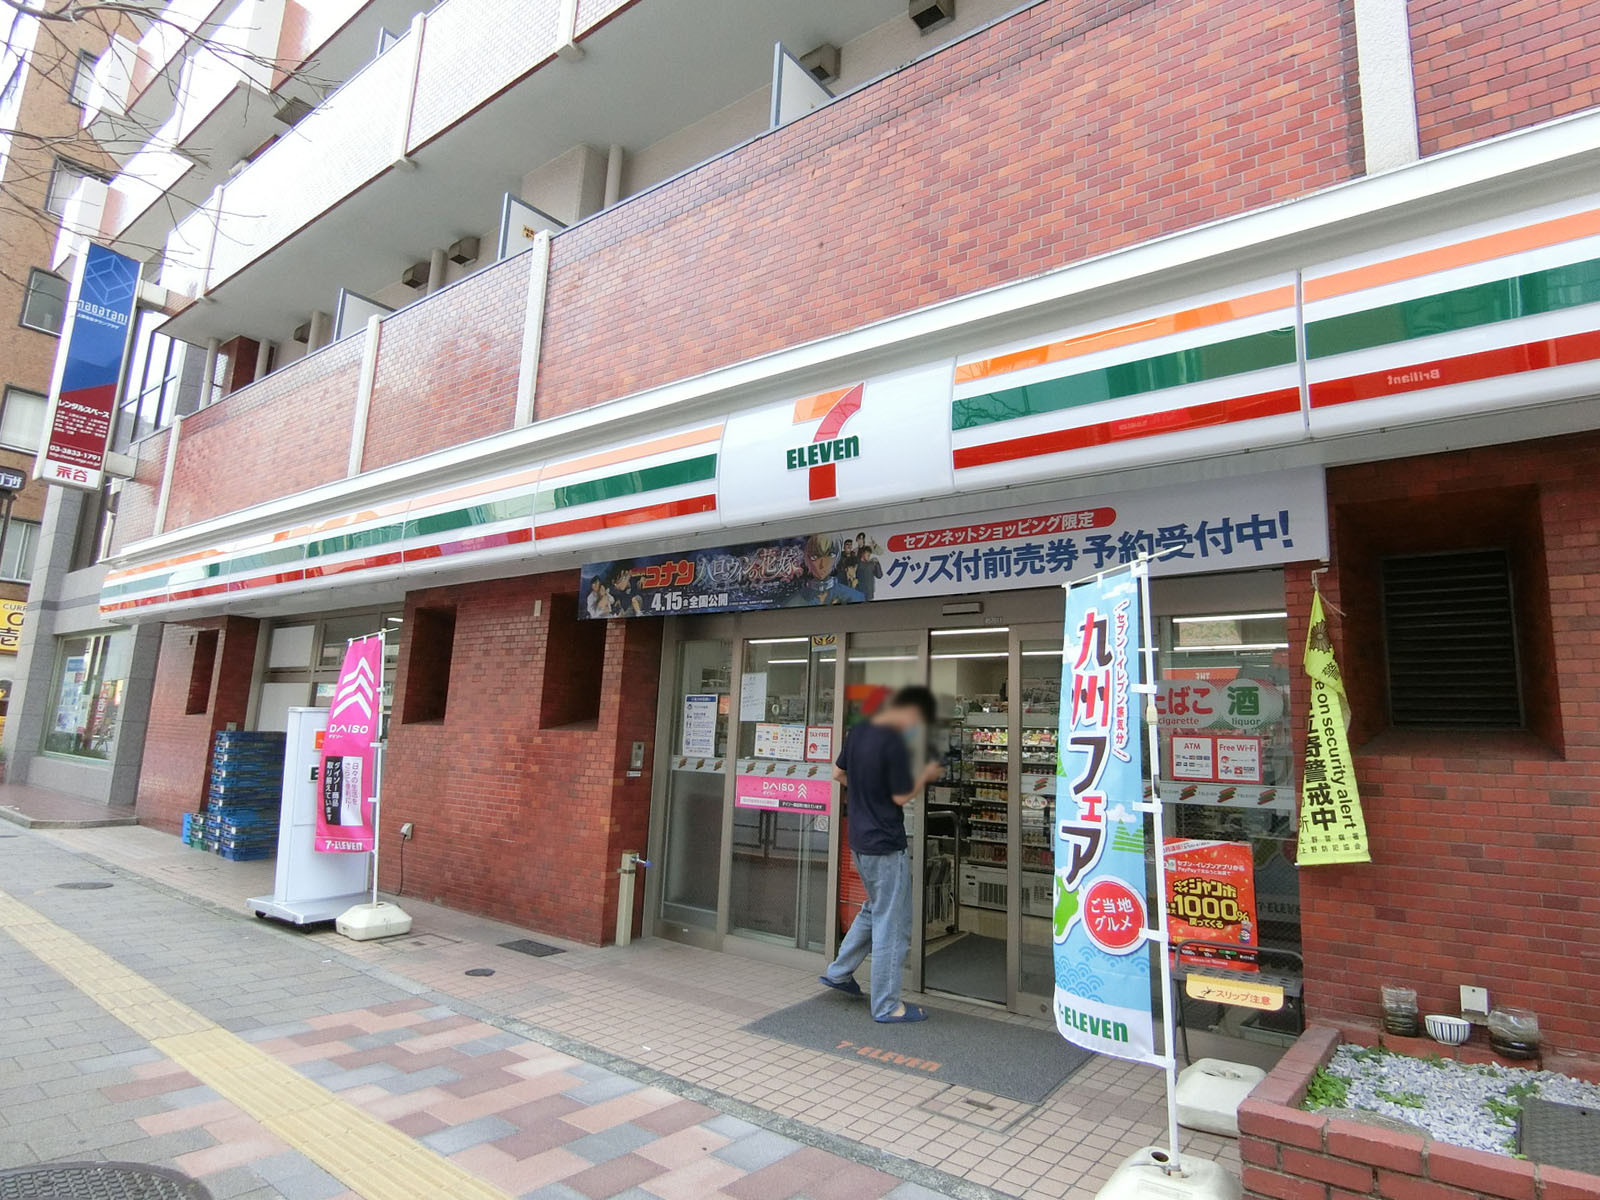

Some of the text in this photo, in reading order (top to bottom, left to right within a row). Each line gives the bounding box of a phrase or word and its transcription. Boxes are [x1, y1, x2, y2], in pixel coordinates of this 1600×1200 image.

[904, 512, 1094, 549] セブンネットショッピング限定
[643, 560, 695, 588] コナン
[1227, 686, 1259, 716] 酒
[1317, 693, 1331, 714] on
[329, 723, 369, 735] DAISO
[1231, 717, 1261, 727] liquor
[1062, 611, 1113, 884] 九州フェア
[1183, 742, 1201, 750] ATM
[1219, 743, 1257, 752] Free Wi-Fi
[1322, 717, 1346, 786] security
[762, 781, 795, 792] DAISO
[1336, 789, 1358, 830] alert
[1090, 897, 1134, 914] ご当地
[1173, 894, 1250, 922] 1000%
[1095, 914, 1133, 932] グルメ
[1215, 989, 1272, 1006] スリップ注意
[1059, 1003, 1129, 1042] -ELEVEn
